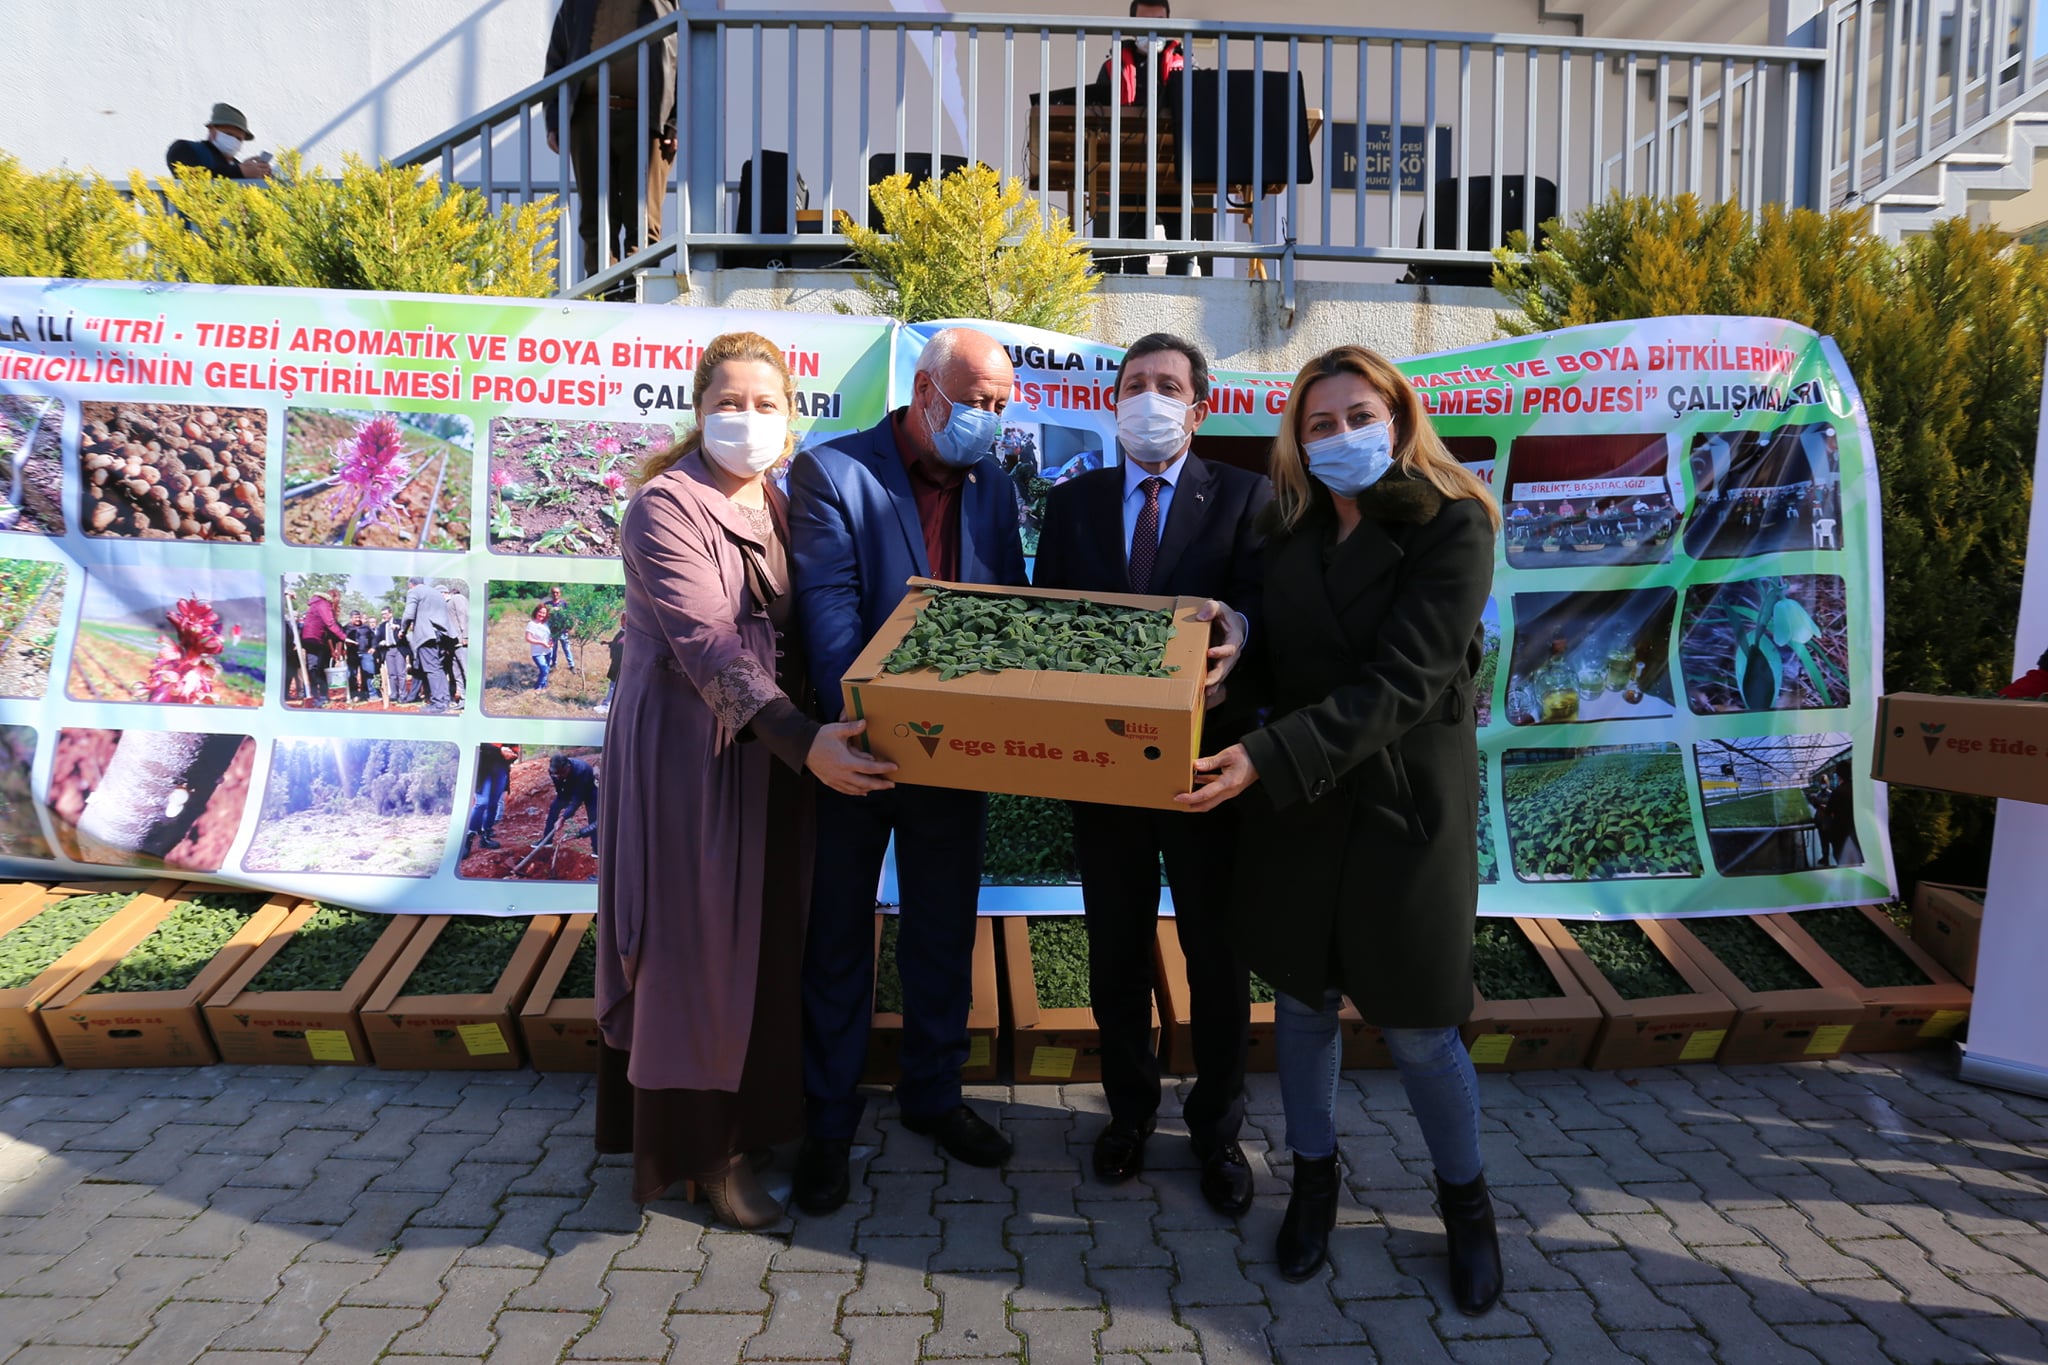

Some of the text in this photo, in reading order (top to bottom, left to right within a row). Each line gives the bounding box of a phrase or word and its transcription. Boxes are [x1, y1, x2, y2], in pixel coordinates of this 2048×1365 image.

[1343, 151, 1425, 173] İNCİRKÖ
[38, 309, 74, 342] İLİ
[85, 315, 165, 344] “ITRİ
[196, 320, 279, 351] TIBBİ
[289, 326, 457, 360] AROMATİK
[467, 335, 507, 361] VE
[518, 338, 601, 366] BOYA
[1003, 342, 1121, 371] UĞLA İL
[1408, 365, 1502, 388] MATİK
[1504, 359, 1550, 378] VE
[1556, 347, 1638, 373] BOYA
[0, 350, 193, 386] İRİCİLİĞİNİN
[205, 358, 461, 400] GELİŞTİRİLMESİ
[472, 374, 623, 406] PROJESİ”
[1522, 379, 1658, 414] PROJESİ”
[1126, 722, 1159, 735] titiz
[949, 738, 1116, 768] ege fide a.ş.
[1946, 737, 1983, 754] ege
[1989, 737, 2038, 756] fide
